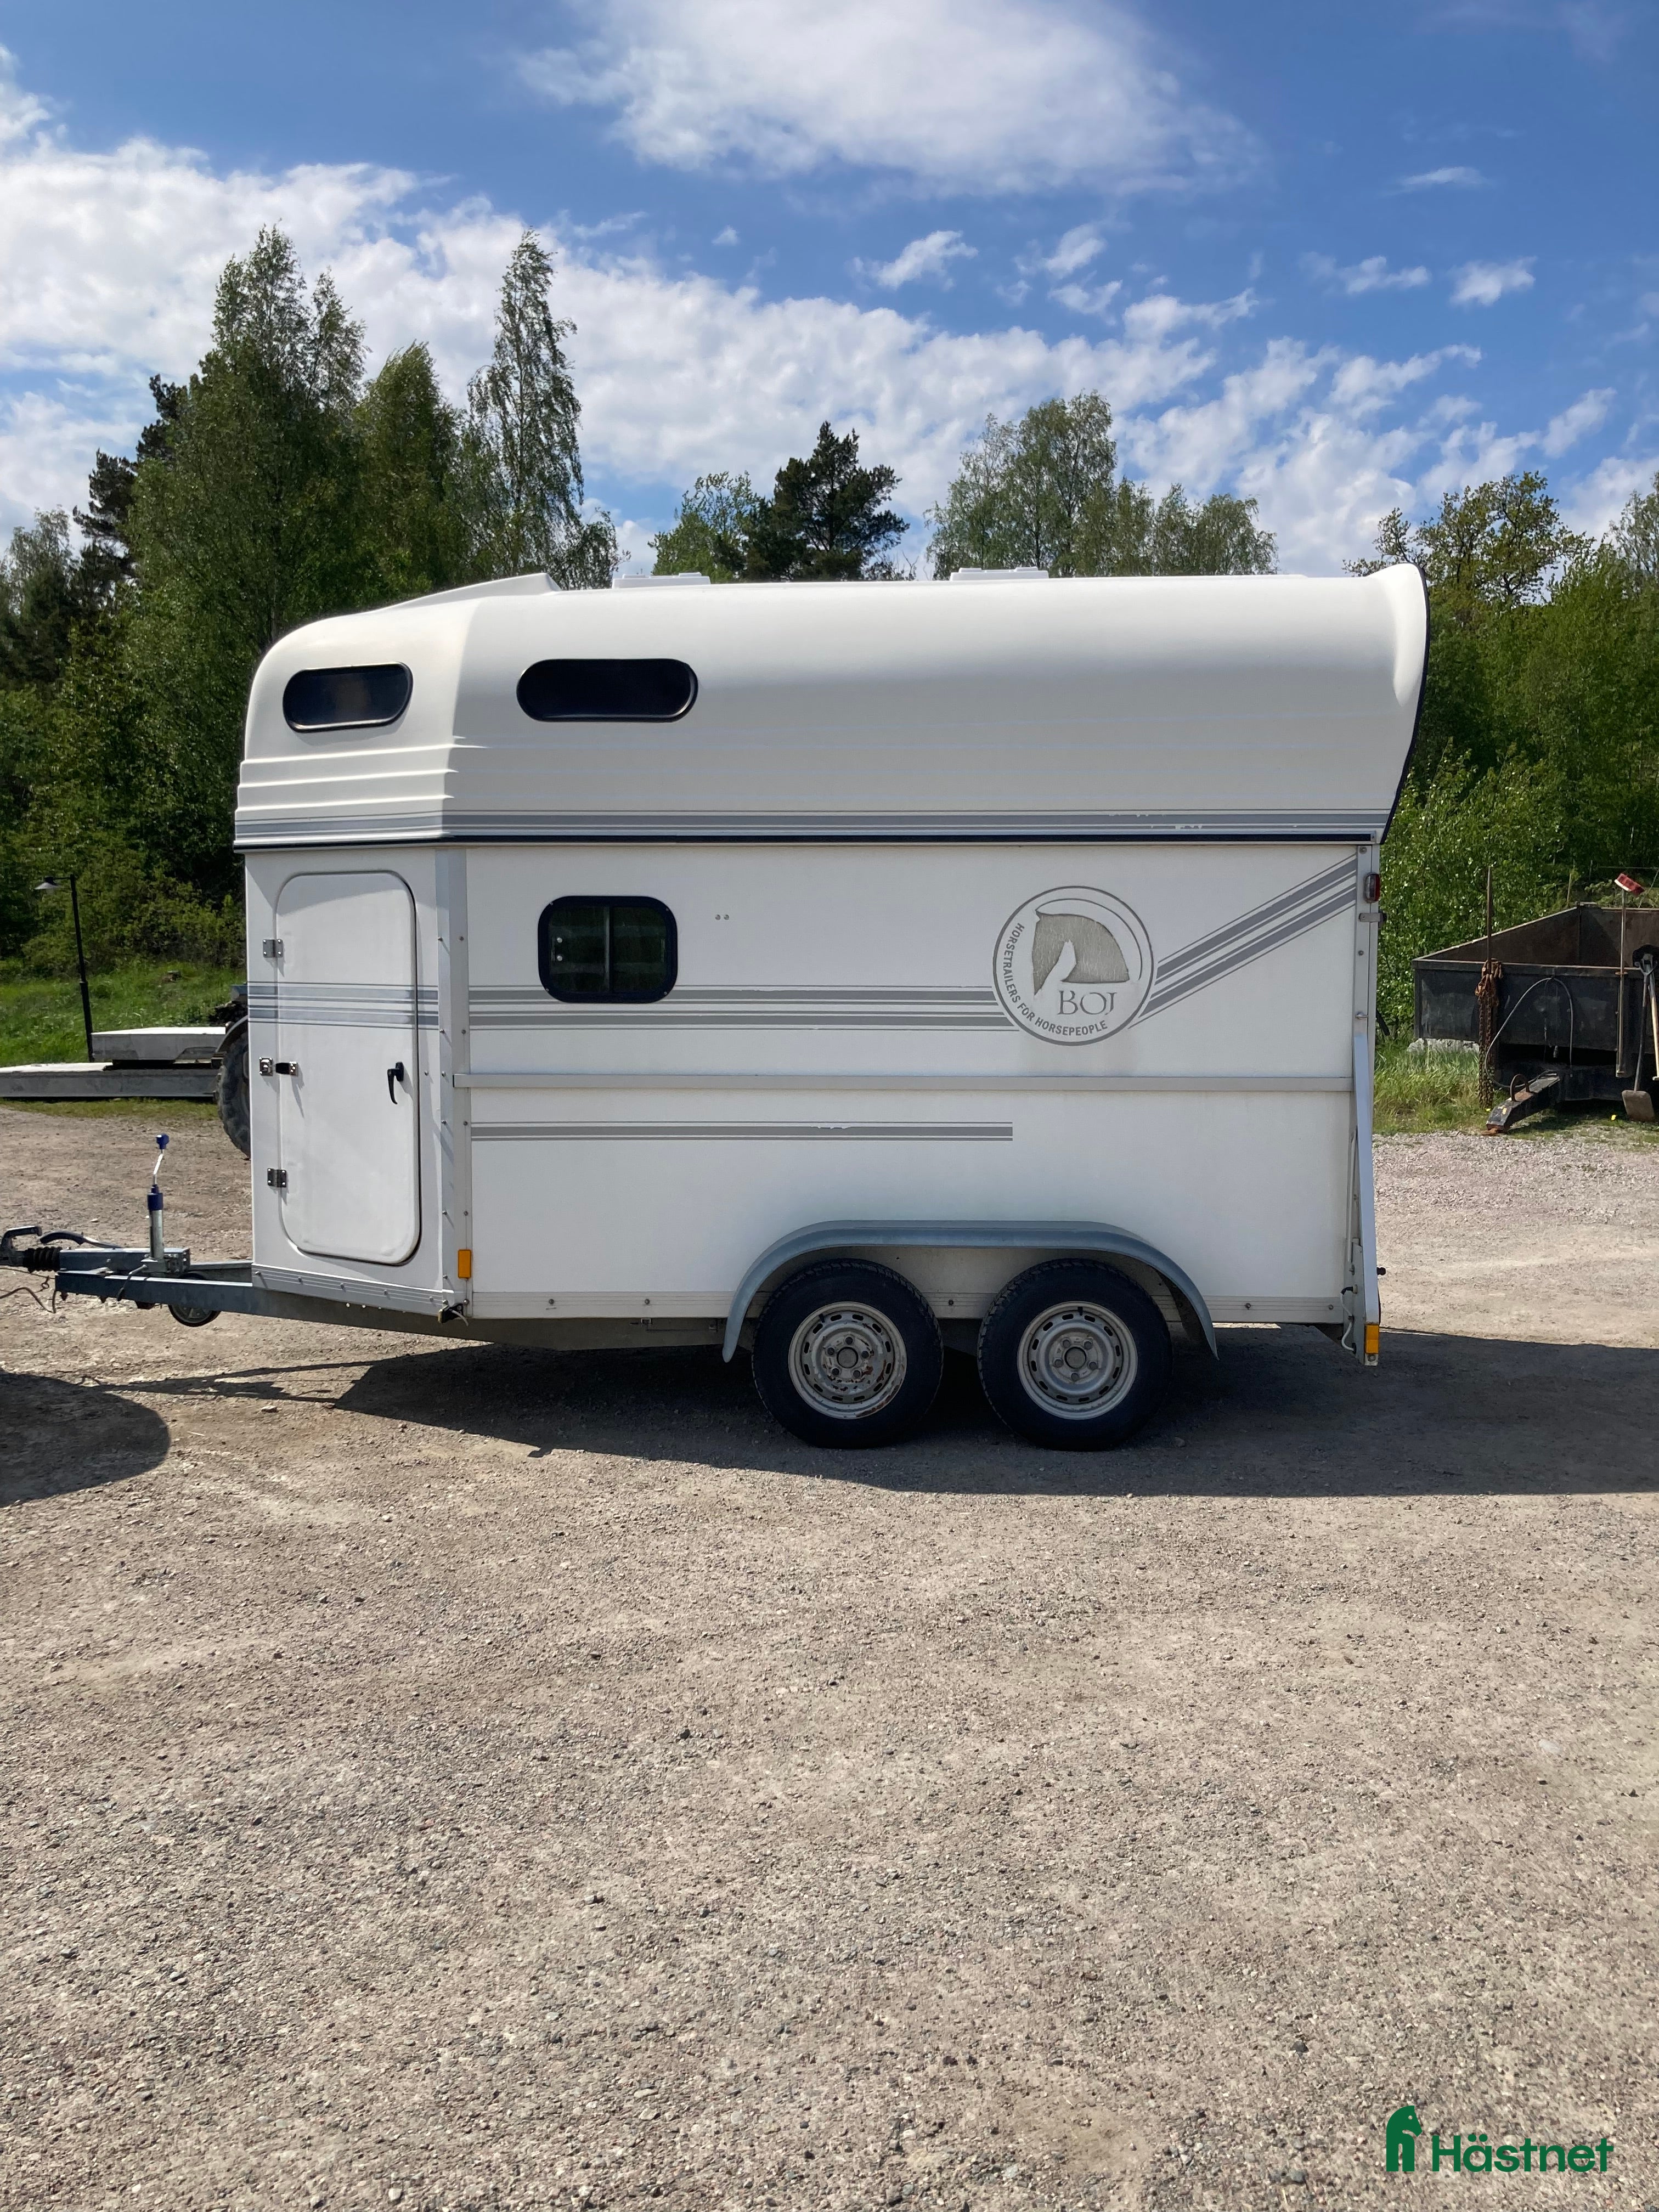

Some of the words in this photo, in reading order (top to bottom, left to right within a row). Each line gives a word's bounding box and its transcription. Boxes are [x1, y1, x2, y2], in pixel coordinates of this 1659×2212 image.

[1003, 923, 1025, 1003] HORSETRAILERS
[1017, 1002, 1036, 1022] FOR
[1035, 1018, 1108, 1036] HORSEPEOPLE
